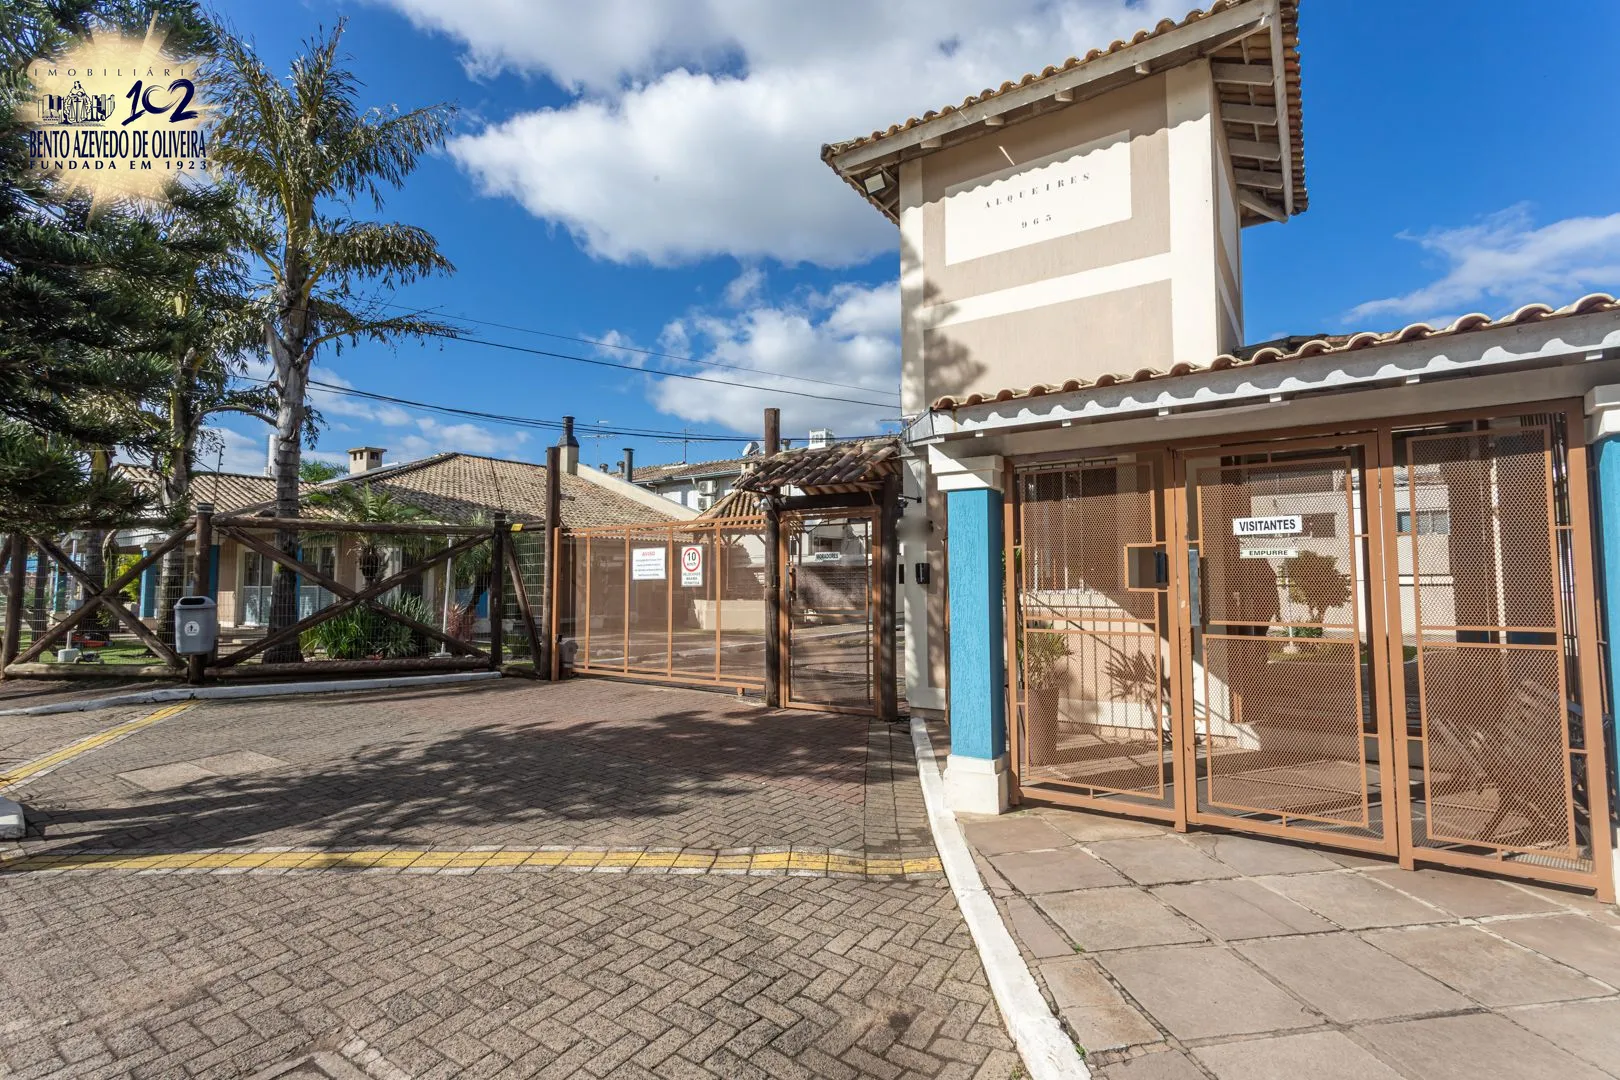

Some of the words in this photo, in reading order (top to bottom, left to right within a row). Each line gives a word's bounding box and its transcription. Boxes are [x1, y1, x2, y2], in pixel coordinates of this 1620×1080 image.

[984, 173, 1090, 209] ALQUEIRES
[1021, 214, 1052, 229] 965
[1239, 519, 1296, 532] VISITANTES
[687, 552, 697, 561] 10
